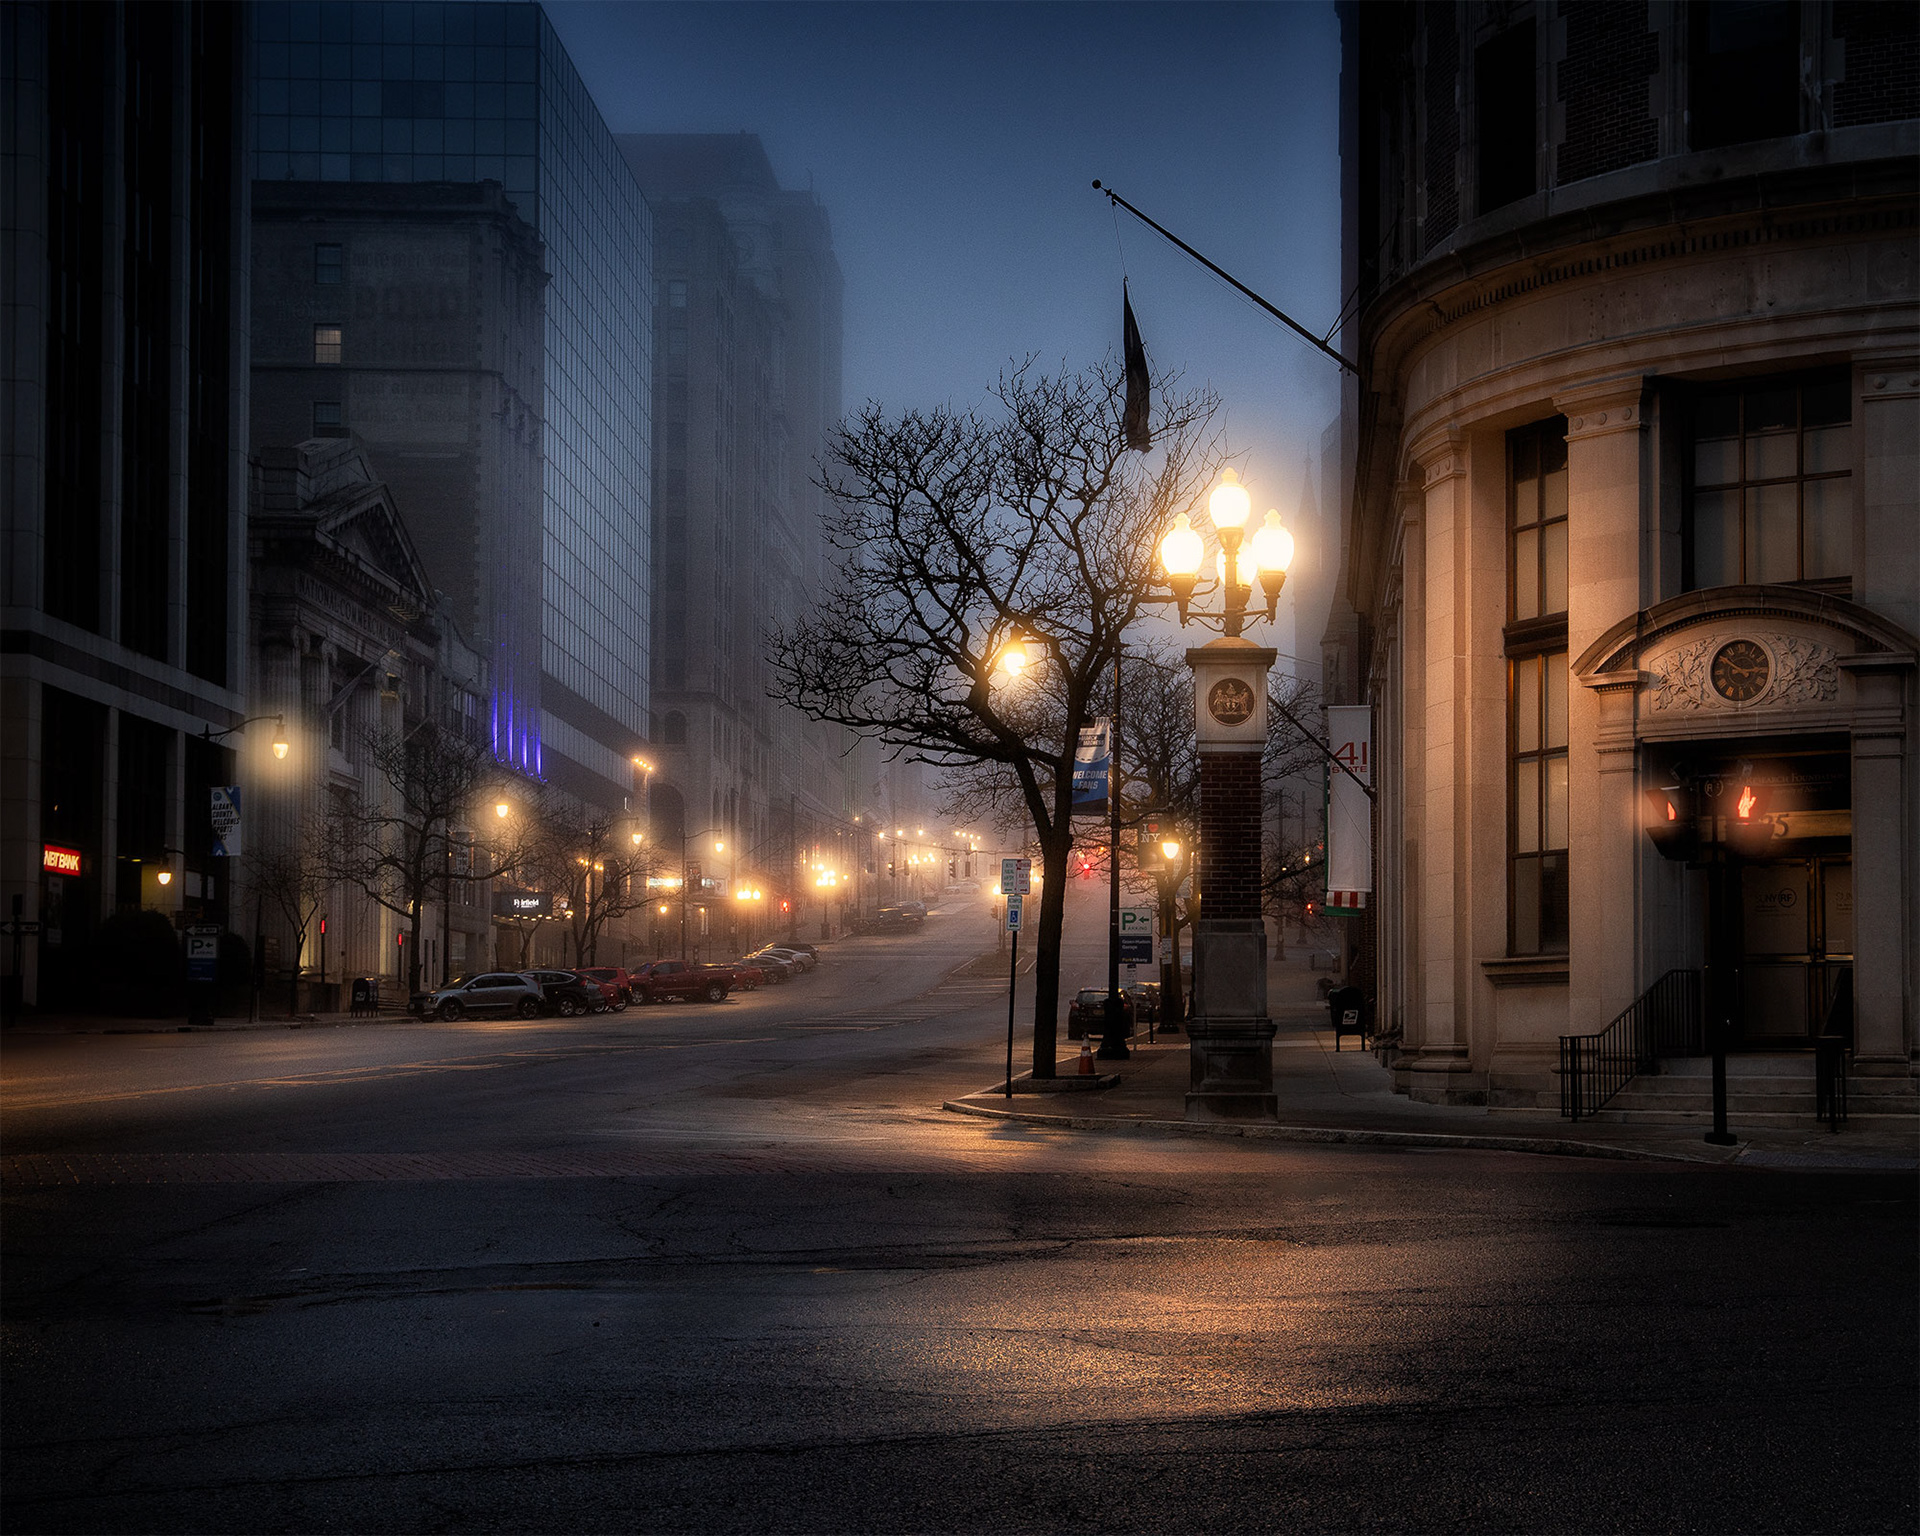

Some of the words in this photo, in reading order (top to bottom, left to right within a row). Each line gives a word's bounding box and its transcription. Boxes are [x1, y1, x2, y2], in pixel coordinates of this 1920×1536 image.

[1333, 742, 1367, 765] 41
[1073, 770, 1108, 779] WELCOME
[1079, 781, 1099, 789] FANS
[1141, 832, 1160, 843] NY
[43, 850, 59, 867] NBT
[58, 853, 79, 871] BANK
